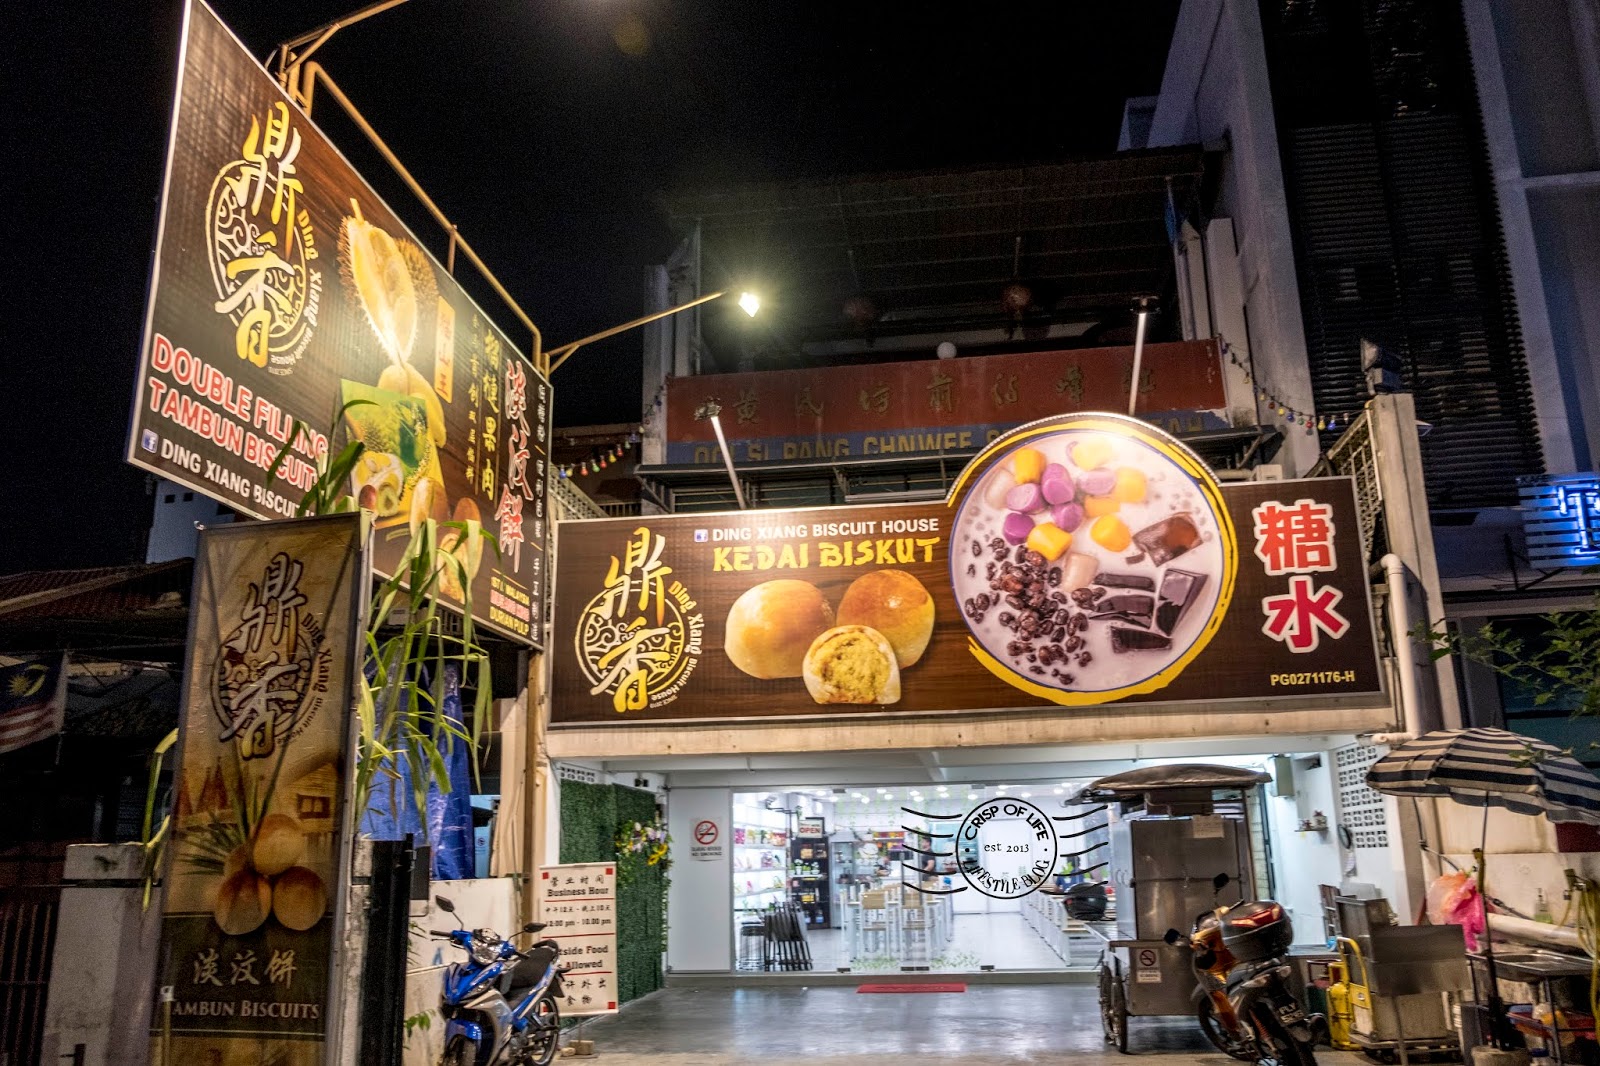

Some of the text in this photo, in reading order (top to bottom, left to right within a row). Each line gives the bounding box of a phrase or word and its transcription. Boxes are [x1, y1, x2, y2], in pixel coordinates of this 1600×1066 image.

[297, 208, 319, 261] Ding
[303, 268, 322, 327] Xiang
[151, 332, 253, 422] DOUBLE
[149, 376, 319, 493] TAMBUN BISCUIT
[161, 438, 202, 474] DING
[204, 459, 250, 498] XIANG
[712, 528, 751, 541] DING
[757, 525, 808, 540] XIANG
[812, 521, 877, 537] BISCUIT
[881, 518, 939, 534] HOUSE
[713, 537, 940, 572] KEDAI BISKUT
[1252, 498, 1350, 654] 糖水
[301, 612, 326, 647] Ding
[651, 580, 705, 701] Ding Xiang Biscuit House
[313, 648, 333, 693] Xiang
[1270, 671, 1355, 686] PG0271176-H
[547, 886, 609, 897] Business Hour
[566, 960, 603, 969] Allowed
[586, 945, 608, 954] Food
[172, 1000, 320, 1019] AMBUN BISCUITS
